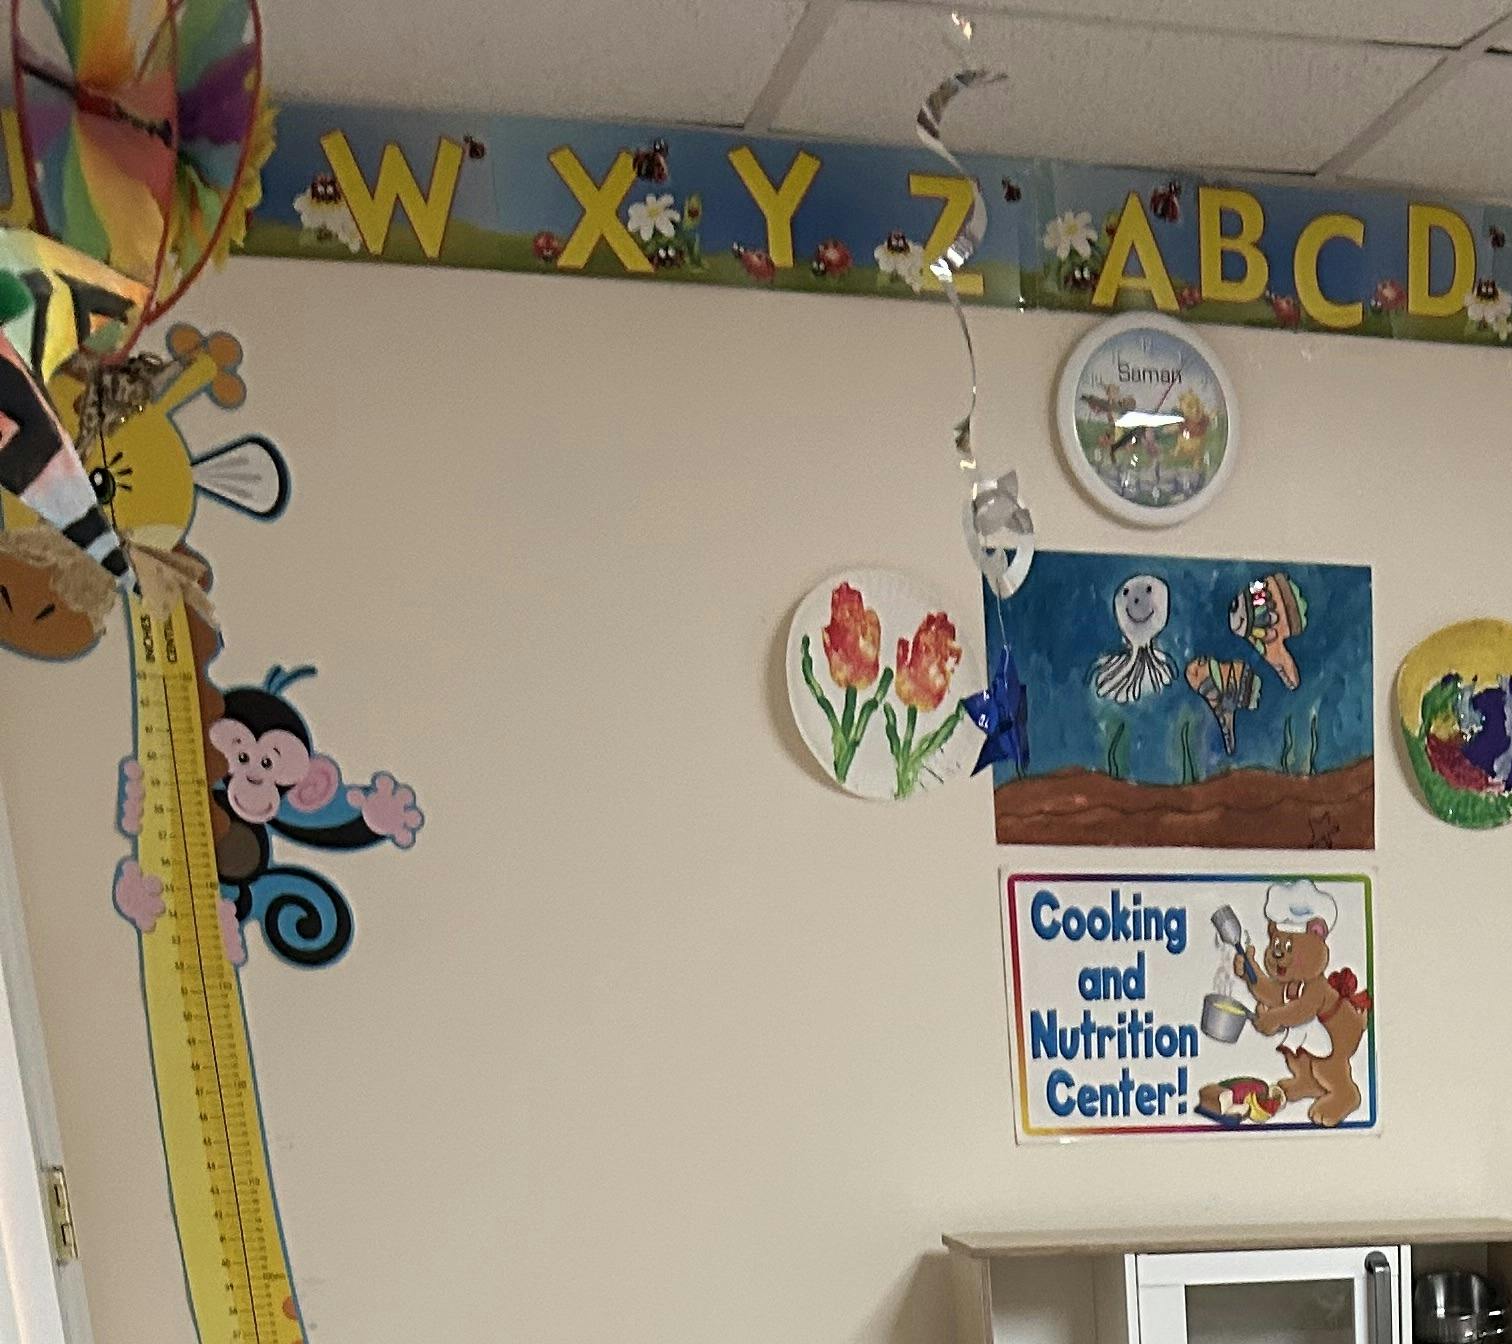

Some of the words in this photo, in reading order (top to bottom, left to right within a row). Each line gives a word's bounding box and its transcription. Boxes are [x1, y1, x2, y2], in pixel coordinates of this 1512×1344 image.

[320, 130, 463, 259] W
[547, 144, 654, 274] X
[728, 144, 821, 269] Y
[909, 173, 983, 295] Z
[1031, 889, 1187, 954] Cooking
[1078, 951, 1146, 1000] and
[1030, 1009, 1199, 1060] Nutrition
[1046, 1066, 1188, 1117] Center!
